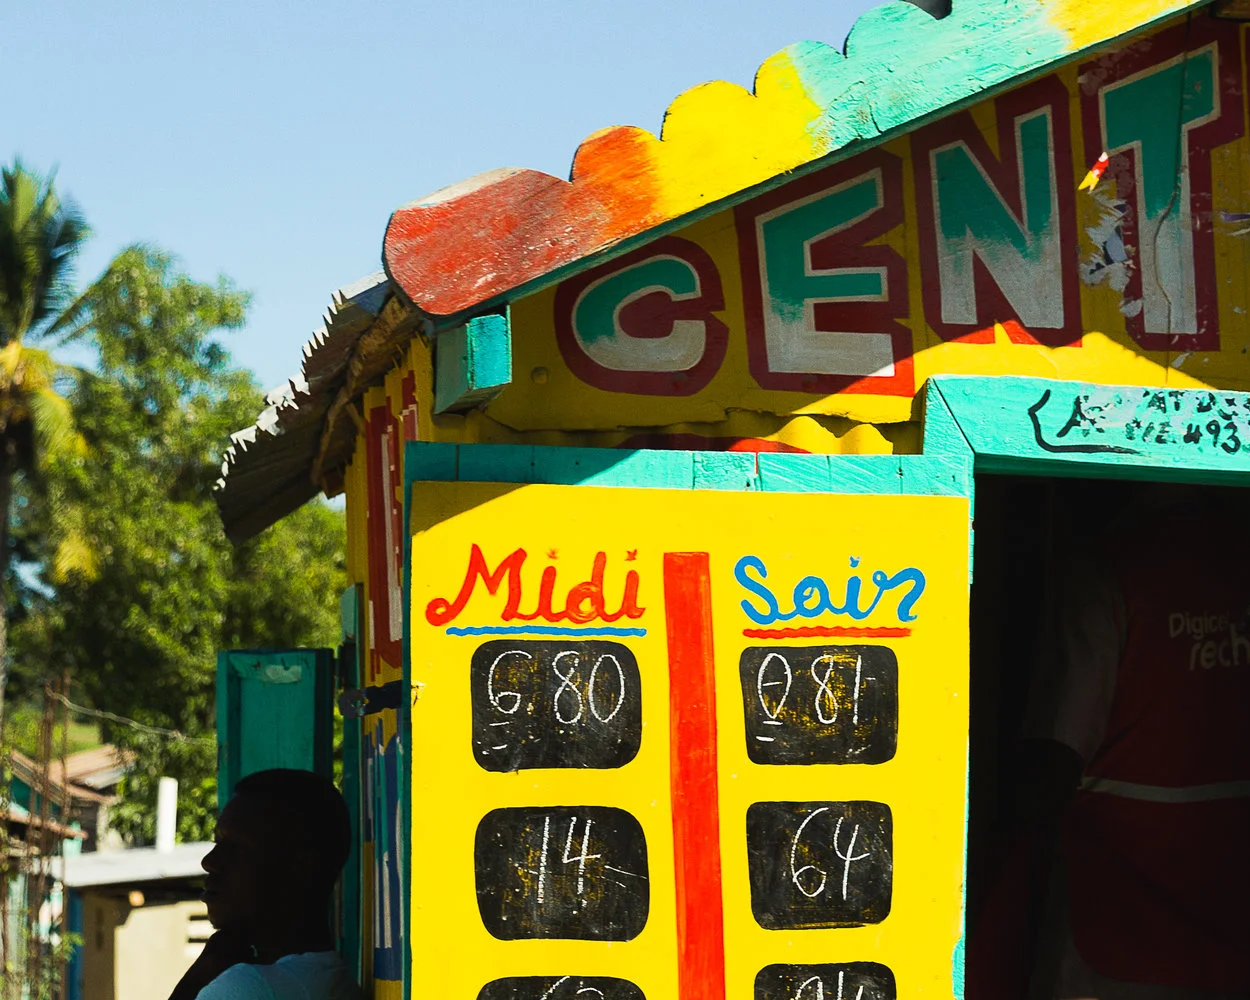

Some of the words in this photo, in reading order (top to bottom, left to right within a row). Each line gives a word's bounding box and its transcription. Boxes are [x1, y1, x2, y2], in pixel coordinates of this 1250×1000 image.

[425, 543, 647, 627] Midi
[534, 815, 602, 905] 14
[790, 806, 871, 901] 64
